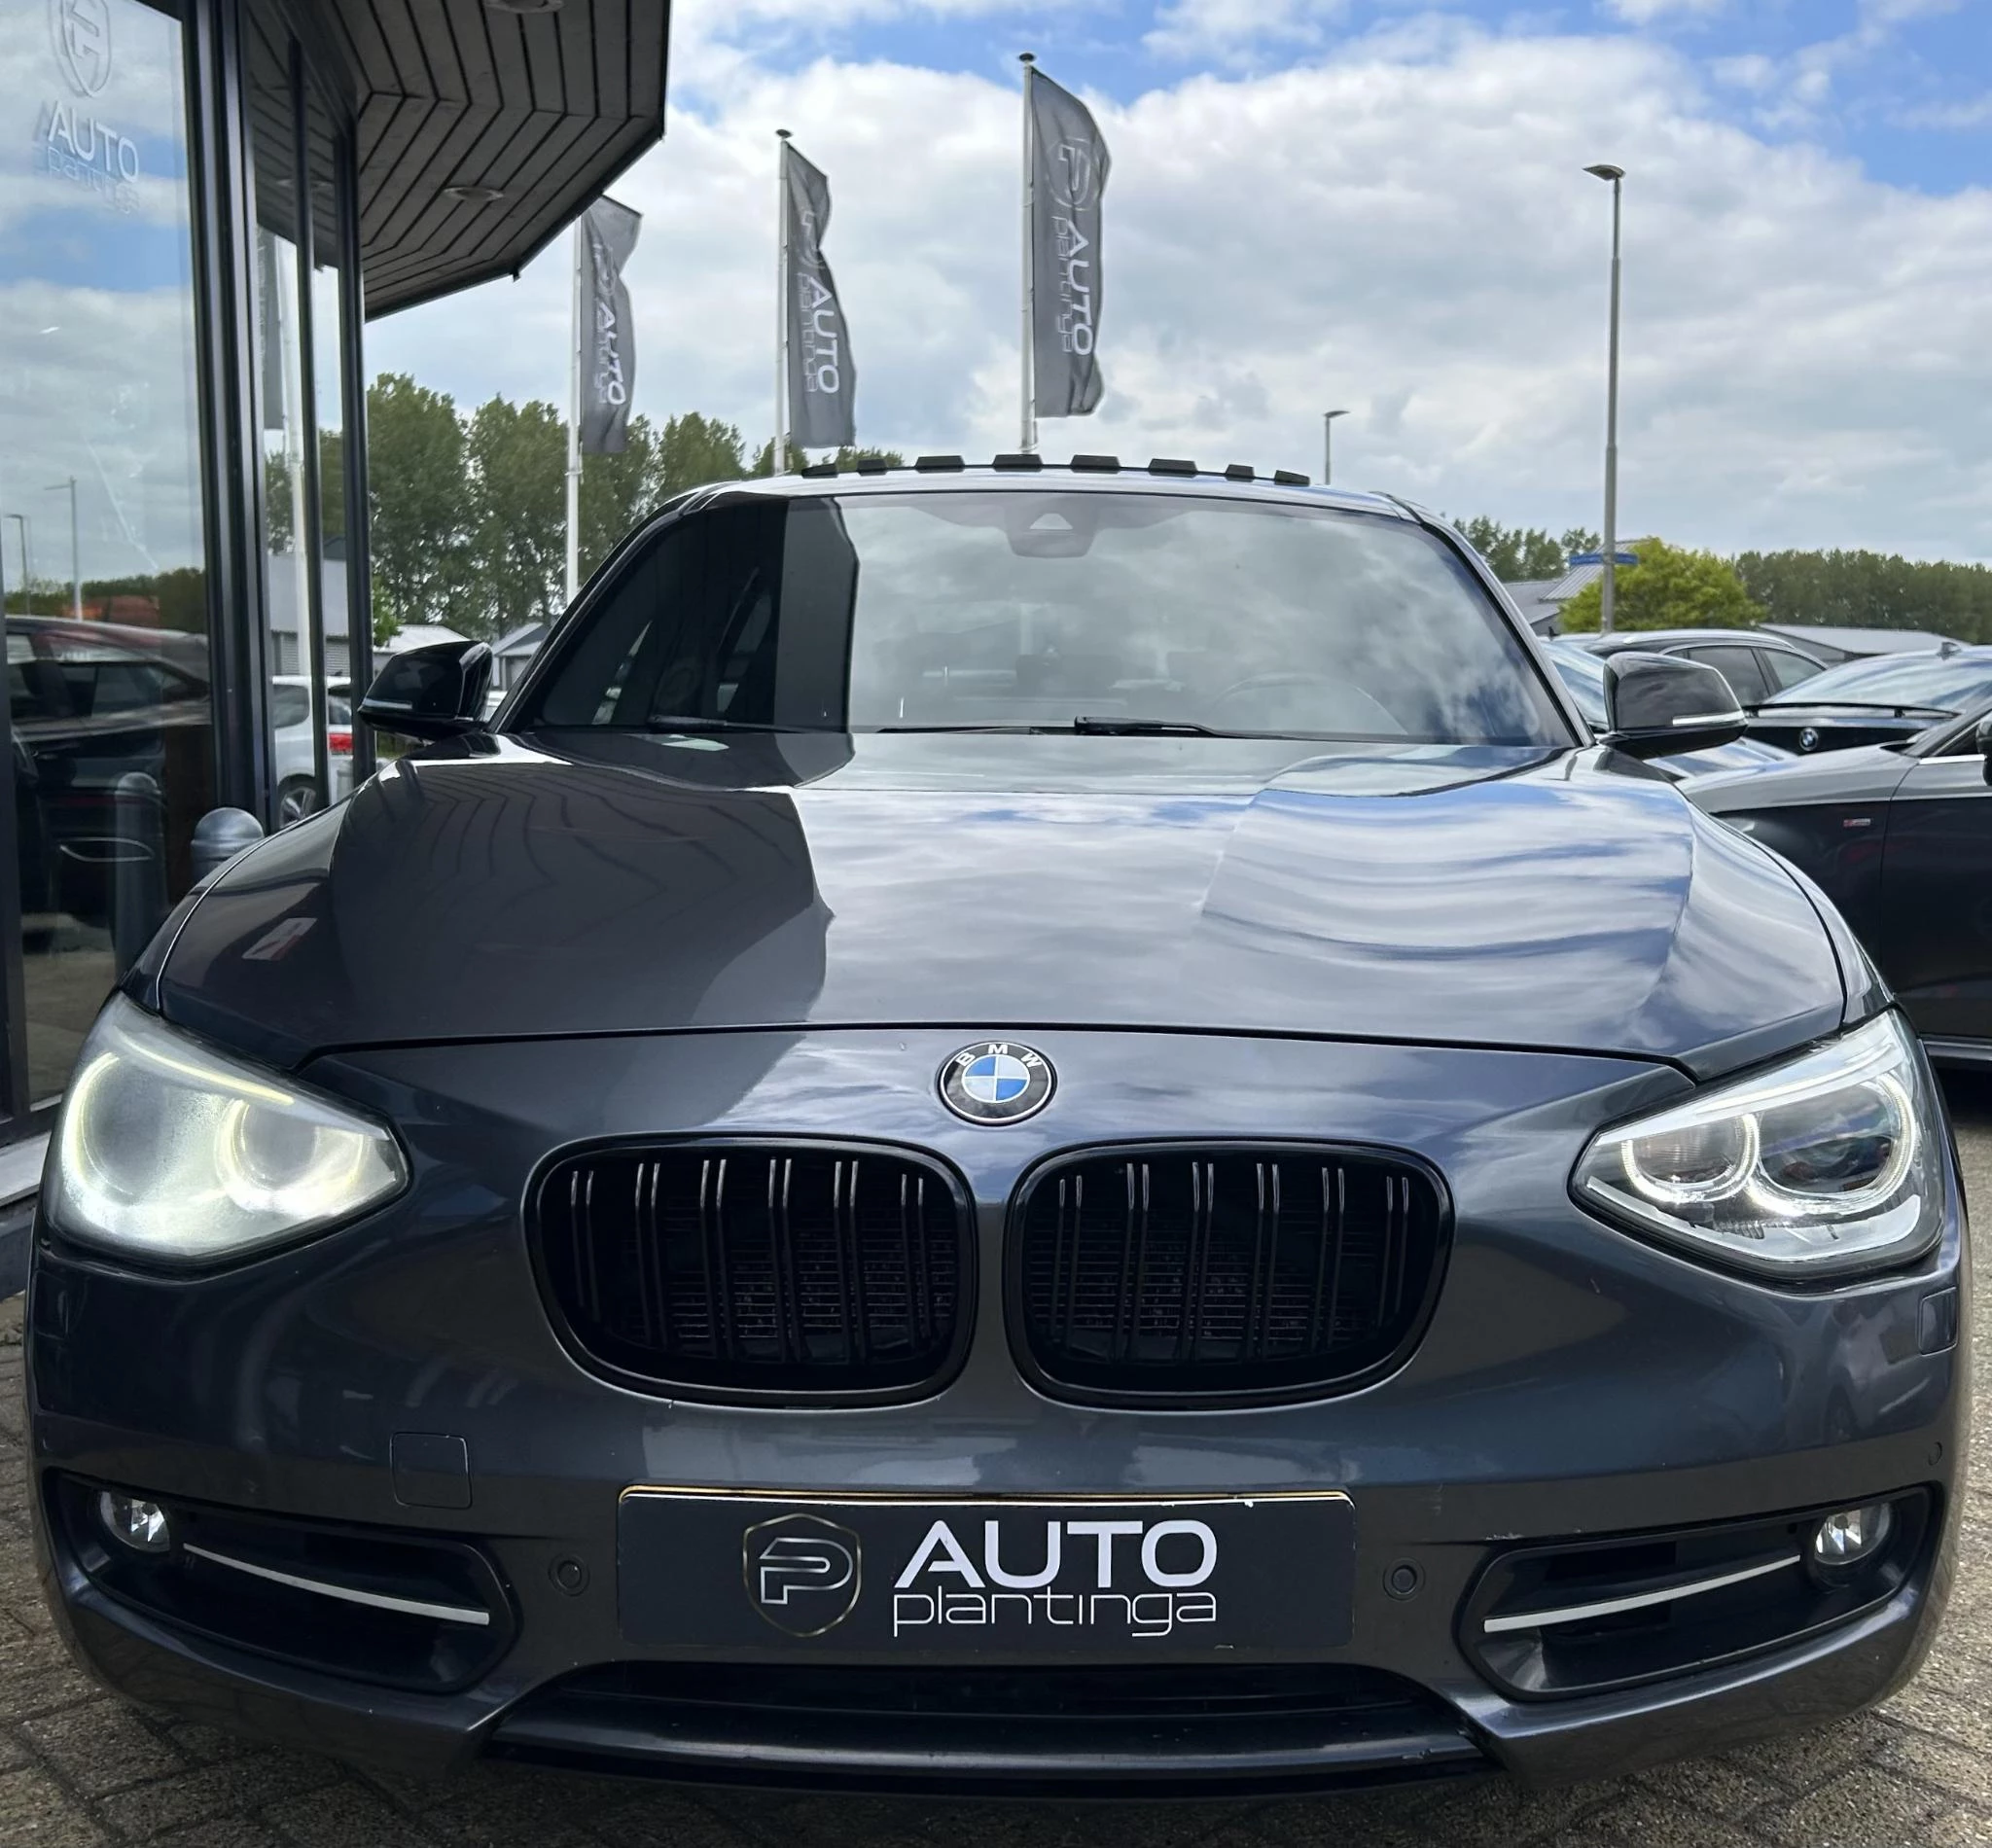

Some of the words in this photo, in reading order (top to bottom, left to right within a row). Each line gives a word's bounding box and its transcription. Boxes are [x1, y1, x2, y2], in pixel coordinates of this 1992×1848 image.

[49, 100, 139, 183] AUTO
[1067, 219, 1094, 356] AUTO
[599, 302, 626, 406] AUTO
[809, 276, 839, 394] AUTO
[955, 1044, 1043, 1068] BMW
[894, 1520, 1217, 1588] AUTO
[893, 1585, 1217, 1637] plantinga
